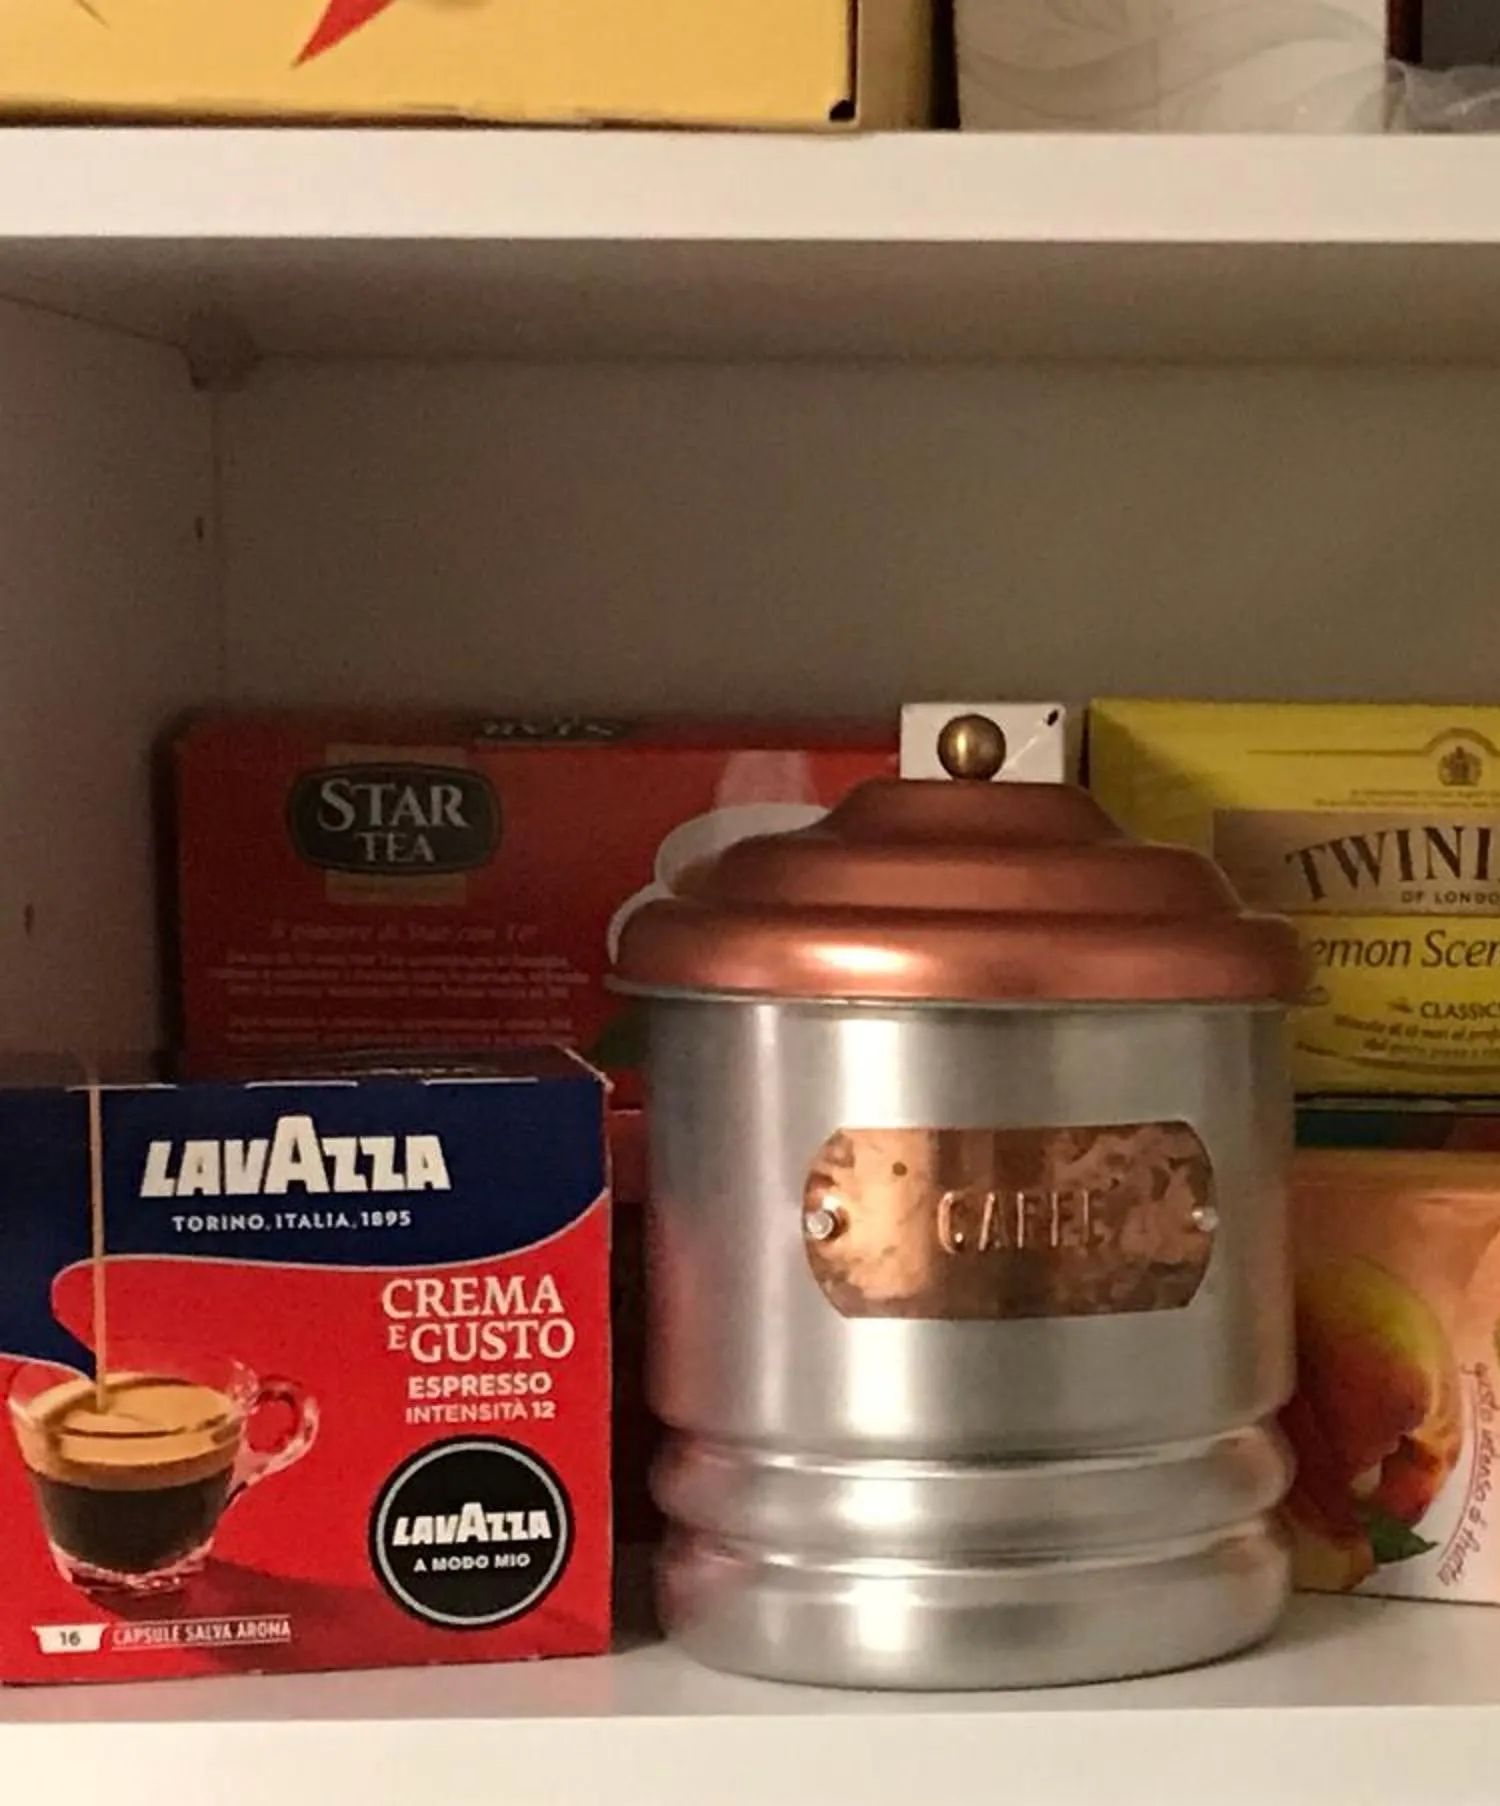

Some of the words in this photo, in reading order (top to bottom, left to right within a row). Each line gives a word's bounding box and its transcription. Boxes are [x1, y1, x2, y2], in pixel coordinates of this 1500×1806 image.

[316, 778, 473, 832] STAR
[355, 833, 436, 864] TEA
[1400, 890, 1427, 905] OF
[1311, 941, 1412, 970] emon
[139, 1114, 451, 1199] LAVAZZA
[360, 1210, 412, 1228] 1895
[380, 1275, 566, 1320] CREMA
[387, 1325, 408, 1352] E
[408, 1318, 575, 1364] GUSTO
[407, 1371, 553, 1400] ESPRESSO
[405, 1400, 528, 1425] INTENSITÀ
[531, 1400, 556, 1421] 12
[391, 1501, 553, 1548] LAVAZZA
[413, 1559, 428, 1573] A
[430, 1556, 489, 1572] MODO
[493, 1553, 531, 1569] MIO
[58, 1631, 81, 1647] 16
[112, 1627, 180, 1648] CAPSULE
[184, 1623, 232, 1644] SALVA
[236, 1620, 291, 1641] AROMA
